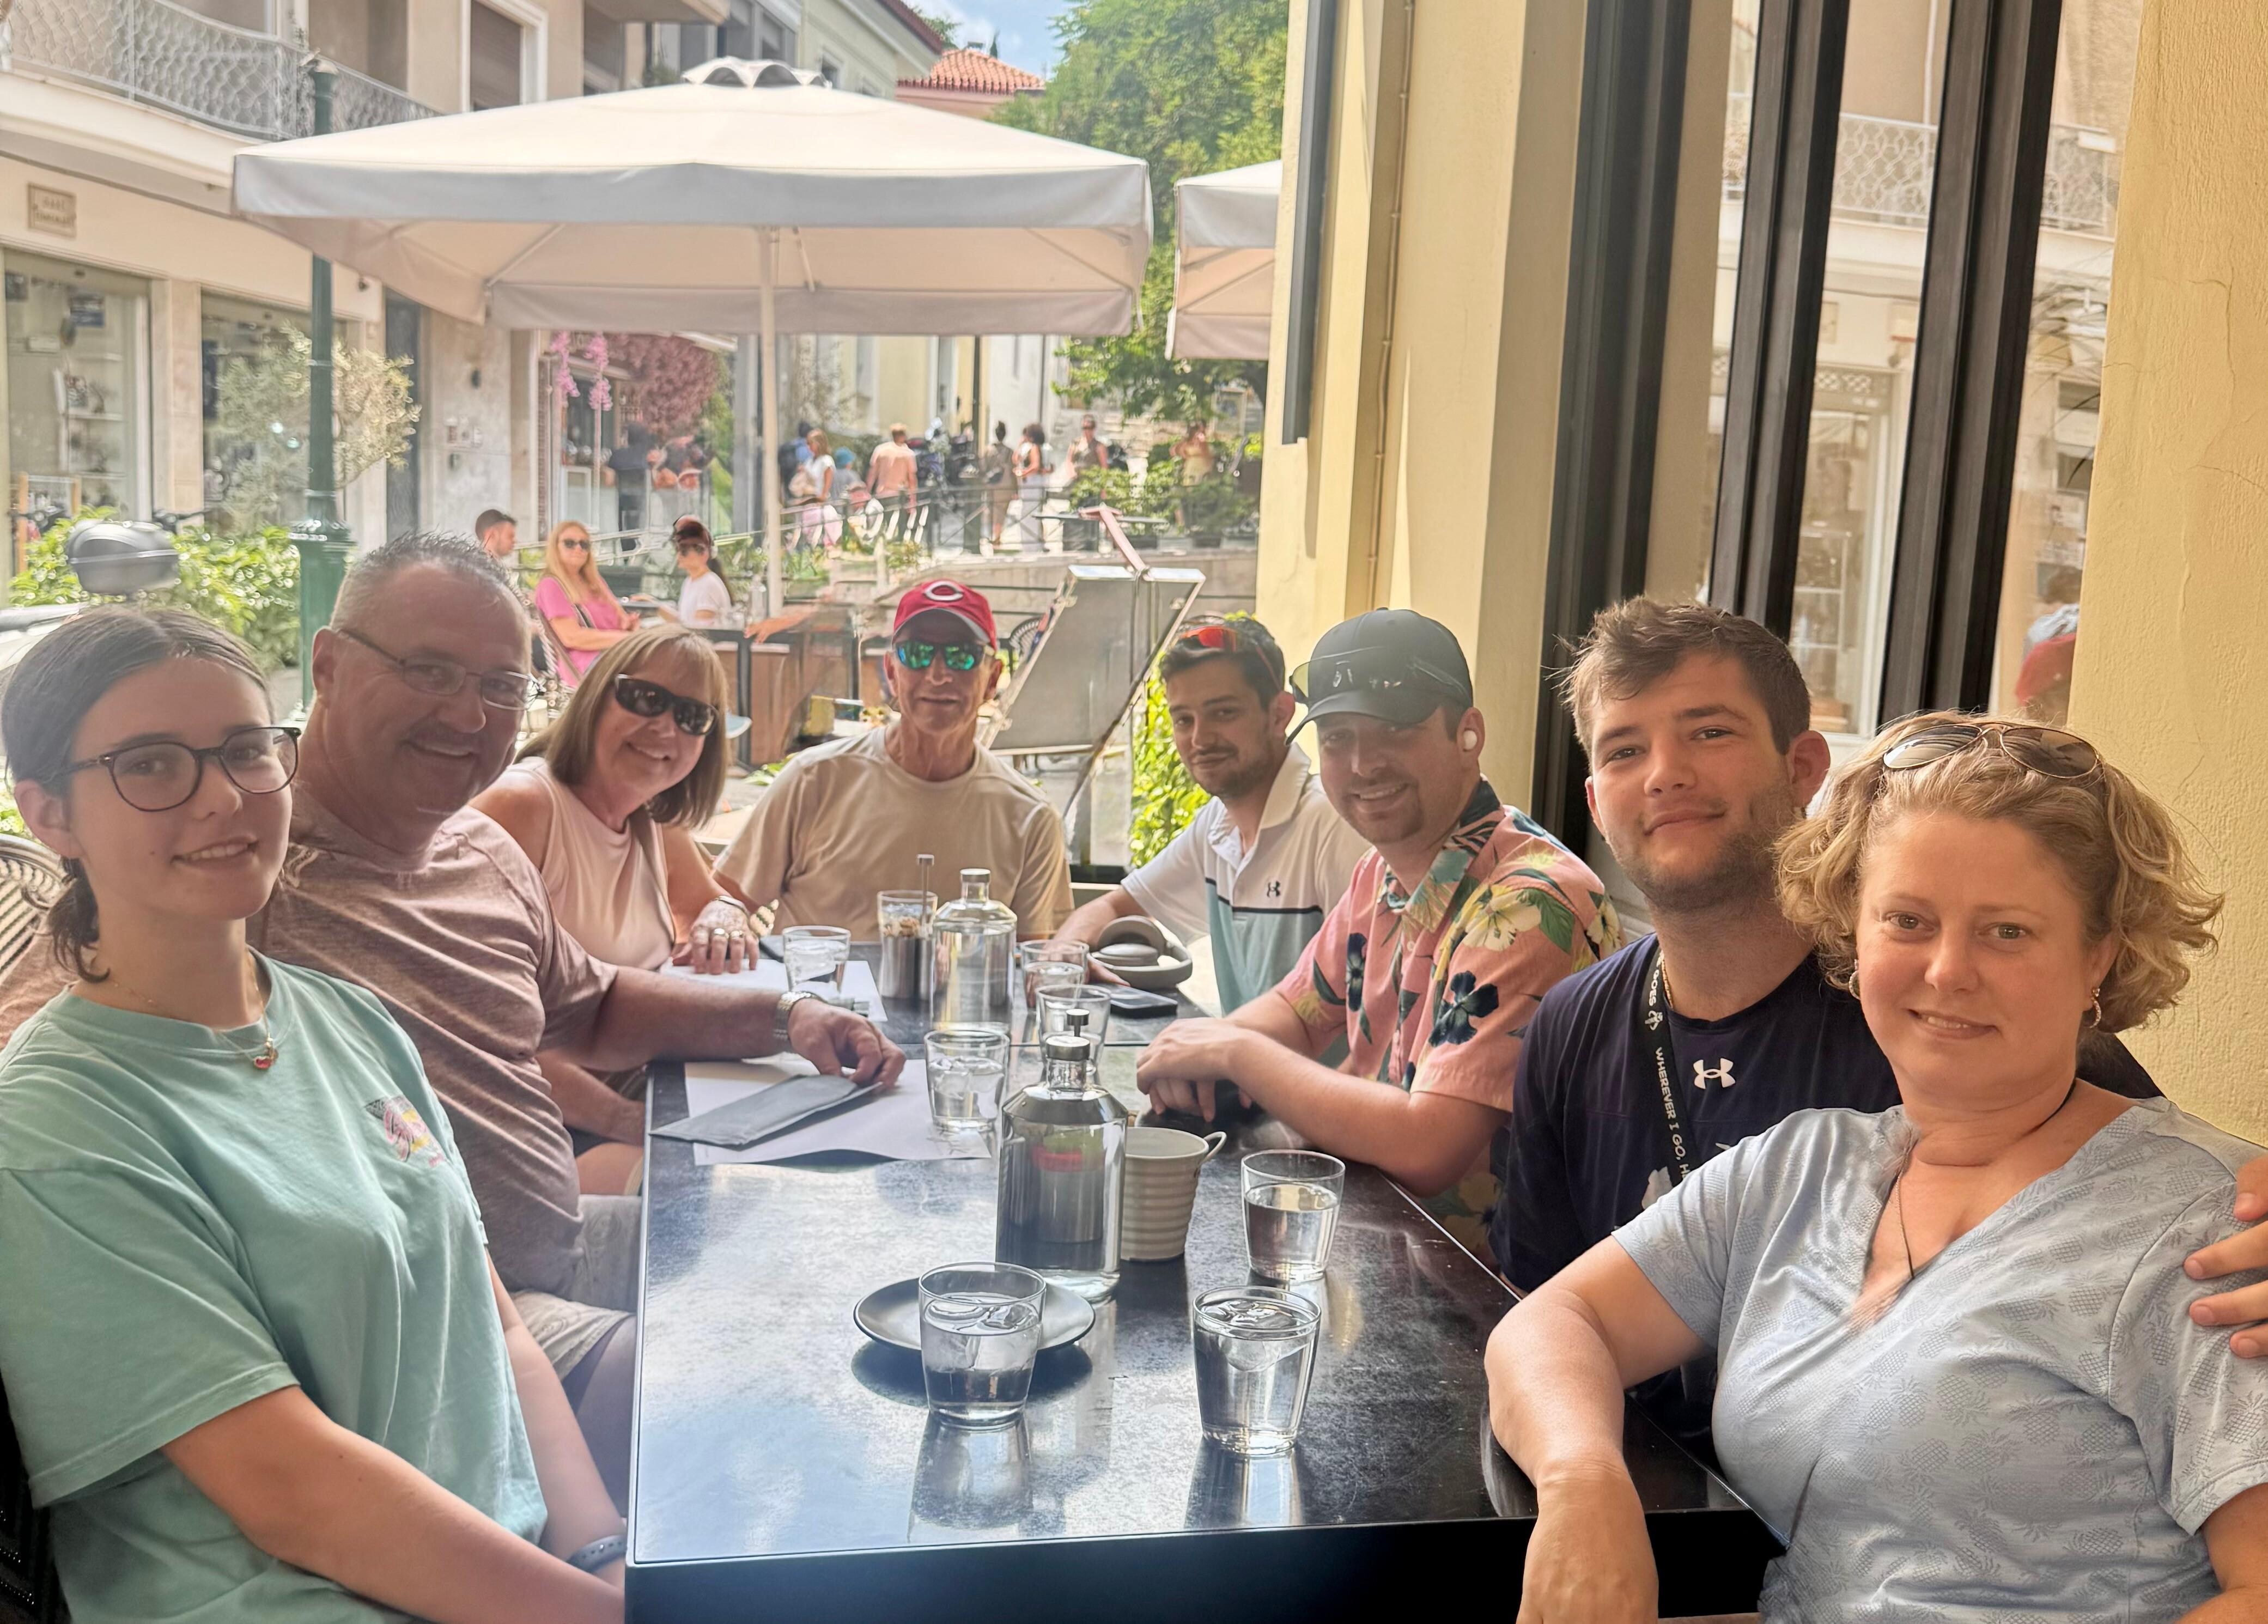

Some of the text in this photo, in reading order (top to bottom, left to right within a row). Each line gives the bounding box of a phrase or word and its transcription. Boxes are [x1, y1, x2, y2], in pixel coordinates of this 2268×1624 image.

[923, 580, 964, 601] C
[1655, 1047, 1677, 1120] WHEREVER
[1669, 1122, 1680, 1131] I
[1672, 1134, 1686, 1160] GO,
